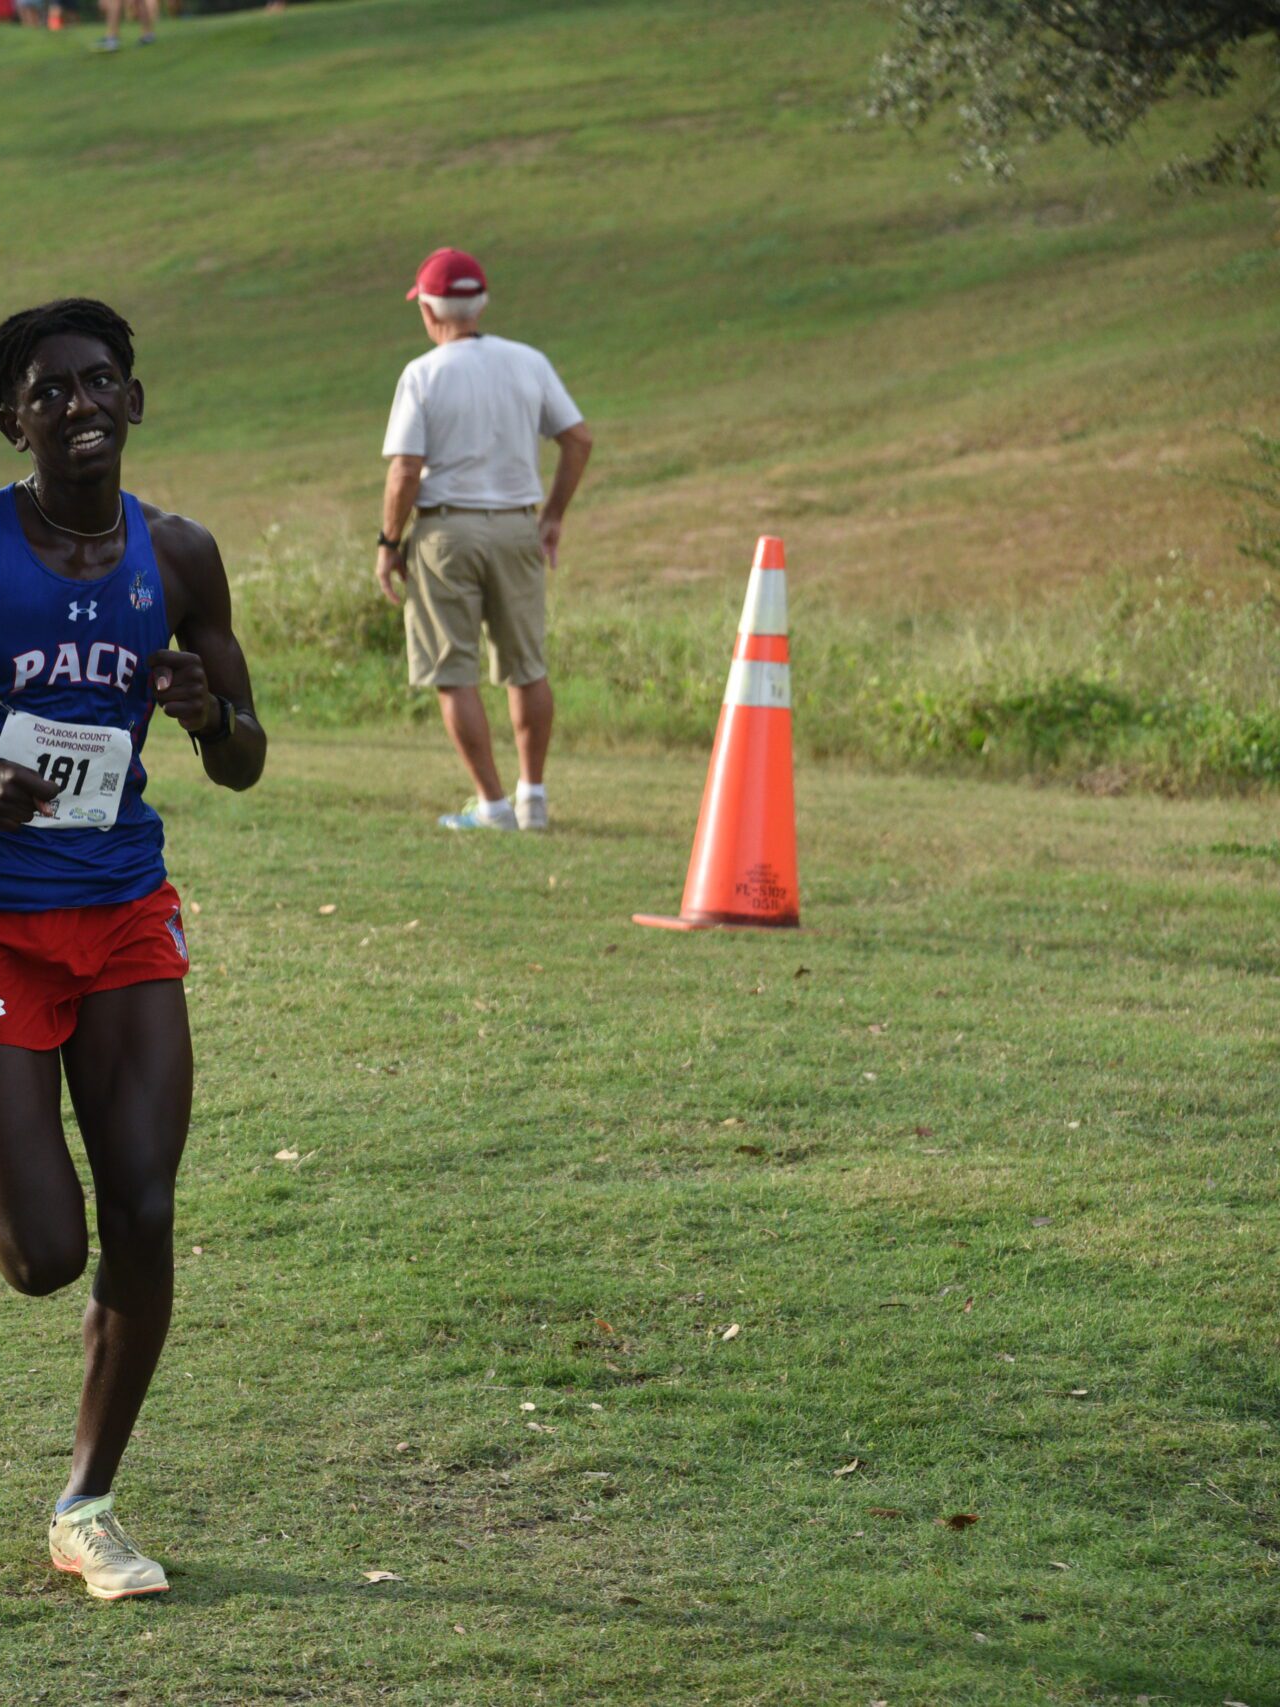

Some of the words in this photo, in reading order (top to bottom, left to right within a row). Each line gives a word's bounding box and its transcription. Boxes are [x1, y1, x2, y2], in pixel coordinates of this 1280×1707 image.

[12, 641, 138, 693] PACE
[33, 723, 79, 740] ESCAROSA
[79, 732, 113, 742] COUNTY
[35, 736, 106, 753] CHAMPIONSHIPS
[36, 753, 90, 796] 181
